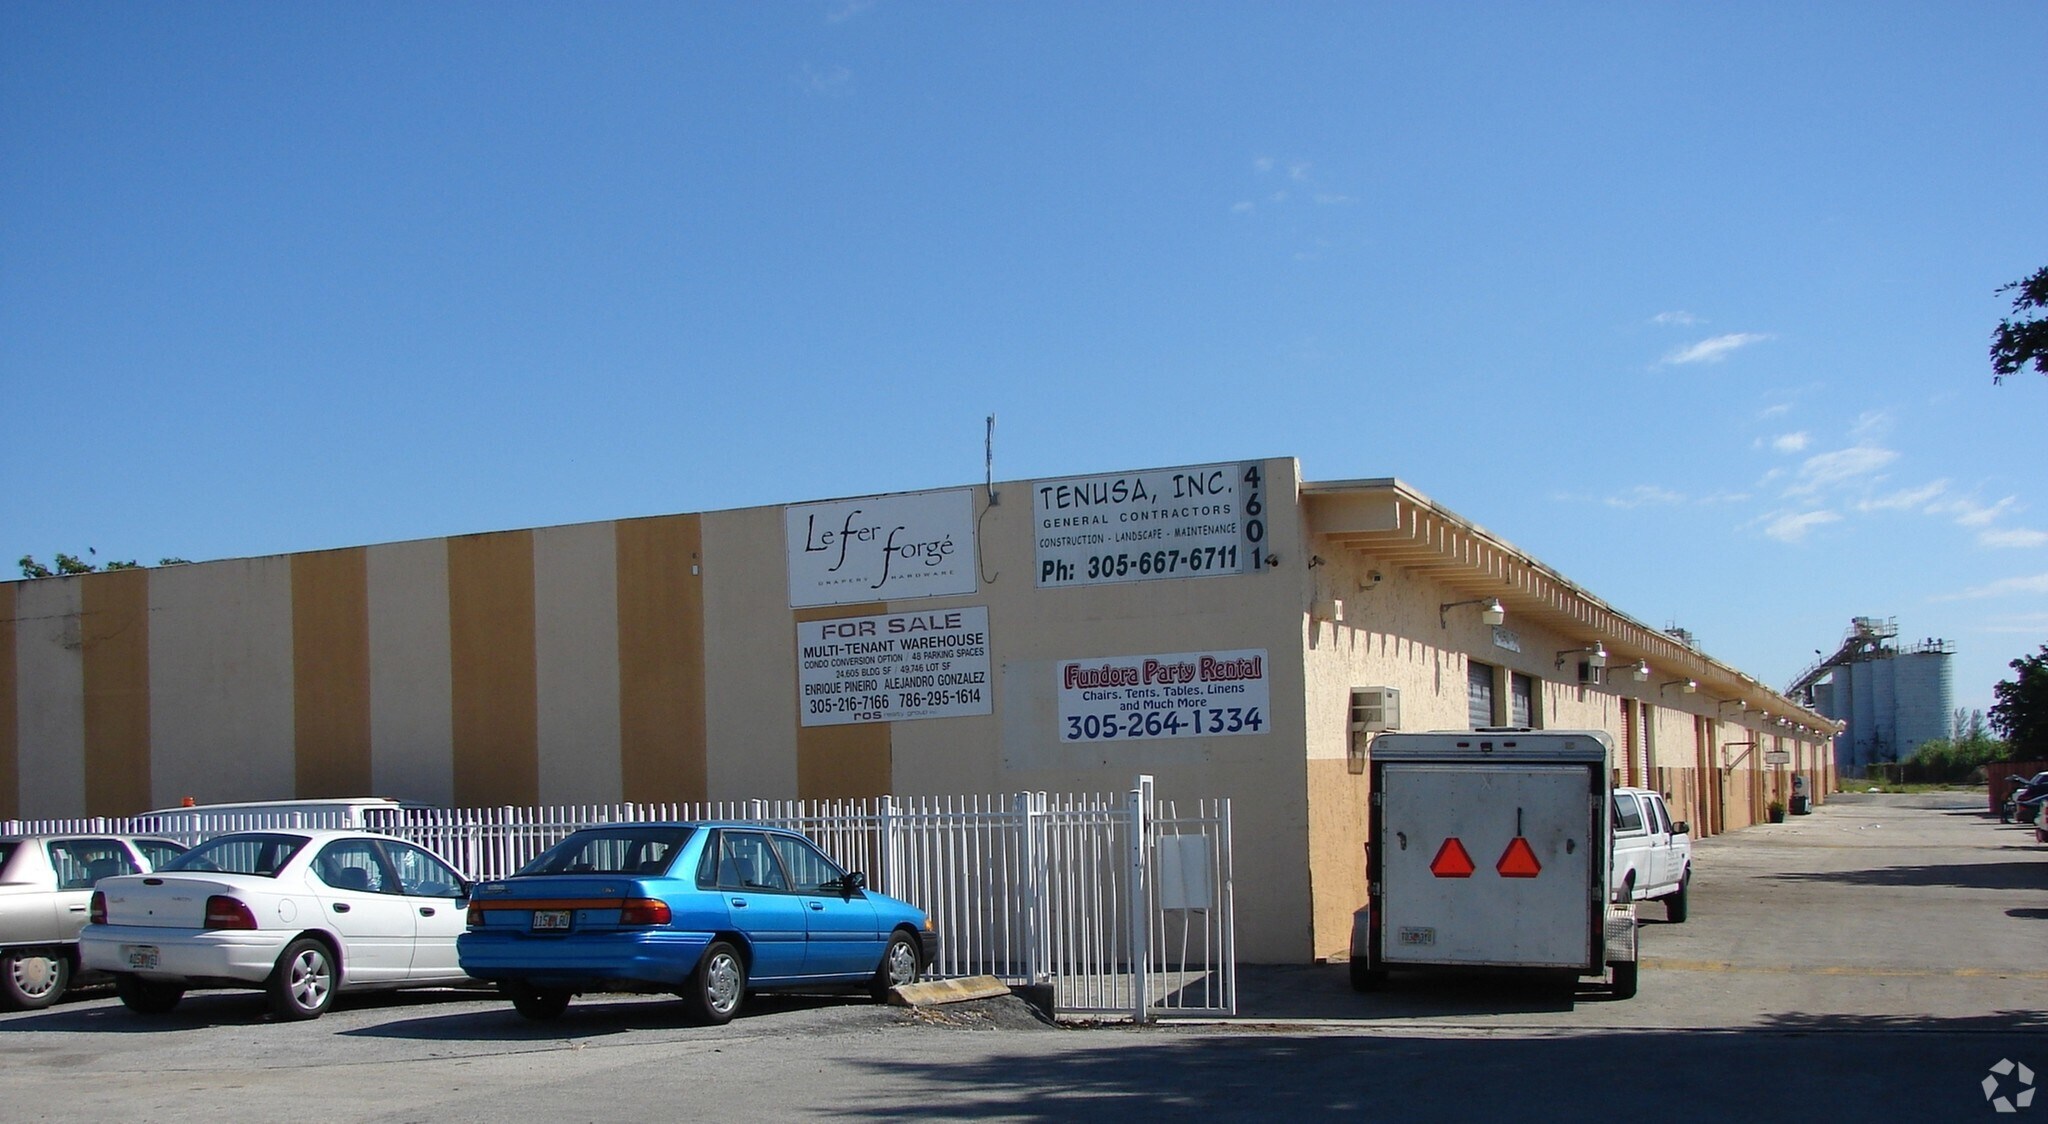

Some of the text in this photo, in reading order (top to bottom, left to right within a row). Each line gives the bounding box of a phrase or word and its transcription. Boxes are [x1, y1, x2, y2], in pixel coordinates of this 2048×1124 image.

[1040, 471, 1232, 510] TENUSA, INC.
[1043, 504, 1231, 529] GENERAL CONTRACTORS
[1243, 466, 1264, 570] 4601
[1039, 533, 1104, 548] CONSTRUCTION
[1115, 528, 1162, 543] LANDSCAPE
[1174, 522, 1236, 538] MAINTENANCE
[871, 526, 954, 590] forgé
[1041, 545, 1237, 582] Ph: 305-667-6711
[818, 570, 954, 586] DRAPERY HARDWARE
[821, 613, 962, 640] FOR SALE
[803, 632, 984, 659] MULTI-TENANT WAREHOUSE
[804, 659, 829, 669] CONDO
[831, 655, 876, 667] CONVERSION
[878, 653, 903, 664] OPTION
[924, 649, 954, 660] PARKING
[956, 647, 985, 658] SPACES
[861, 667, 880, 677] BLDG
[882, 665, 892, 675] SF
[926, 662, 940, 672] LOT
[942, 661, 952, 671] SF
[1064, 655, 1262, 689] Fundora Party Rental
[805, 671, 985, 695] ENRIQUE PINEIRO ALEJANDRO GONZALEZ
[1207, 684, 1245, 695] Linens
[810, 688, 981, 714] 305-216-7166 786-295-1614
[1119, 698, 1207, 711] and Much More
[1067, 707, 1262, 740] 305-264-1334
